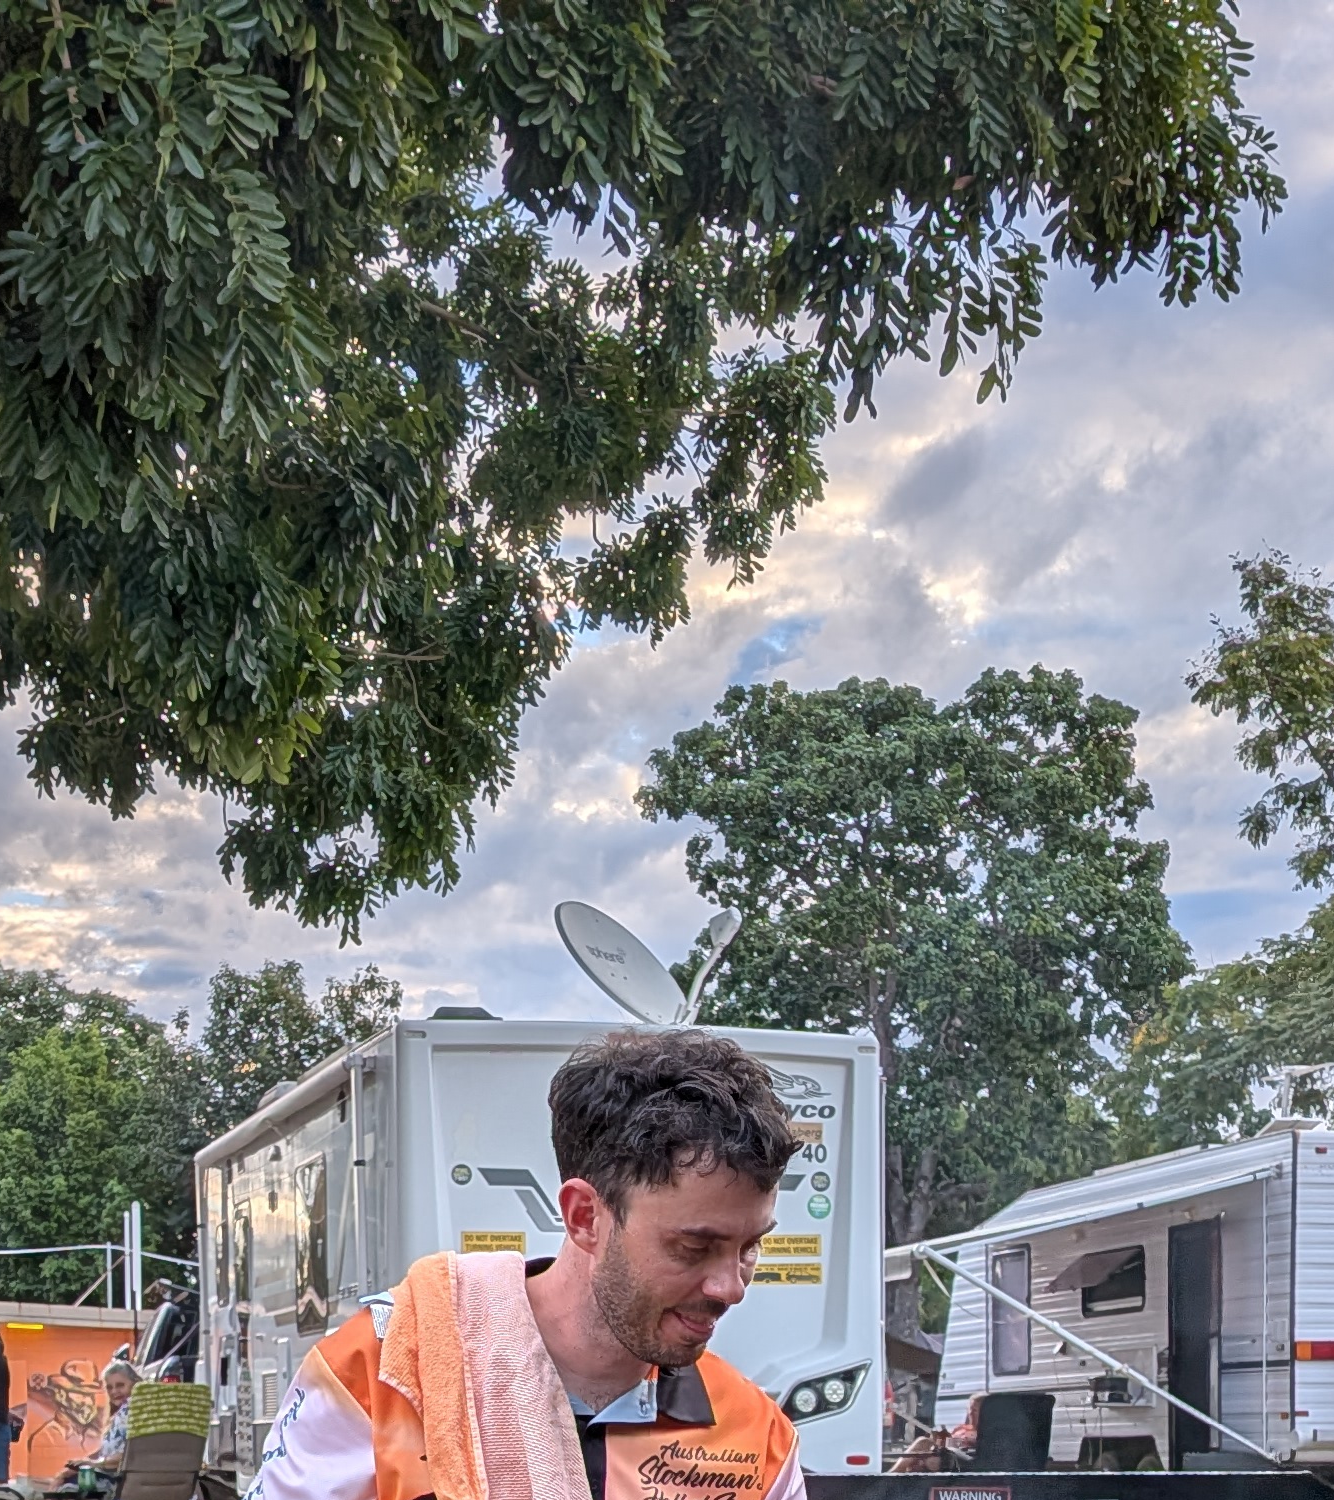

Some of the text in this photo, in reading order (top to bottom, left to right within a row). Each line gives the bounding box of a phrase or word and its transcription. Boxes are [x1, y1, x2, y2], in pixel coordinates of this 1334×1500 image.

[784, 1104, 836, 1121] yco
[464, 1234, 522, 1242] DO NOT OVERTAKE
[763, 1237, 818, 1245] DO NOT OVERTAKE
[764, 1247, 791, 1255] TURNING
[660, 1439, 760, 1465] Australian
[637, 1455, 765, 1491] Stockman's
